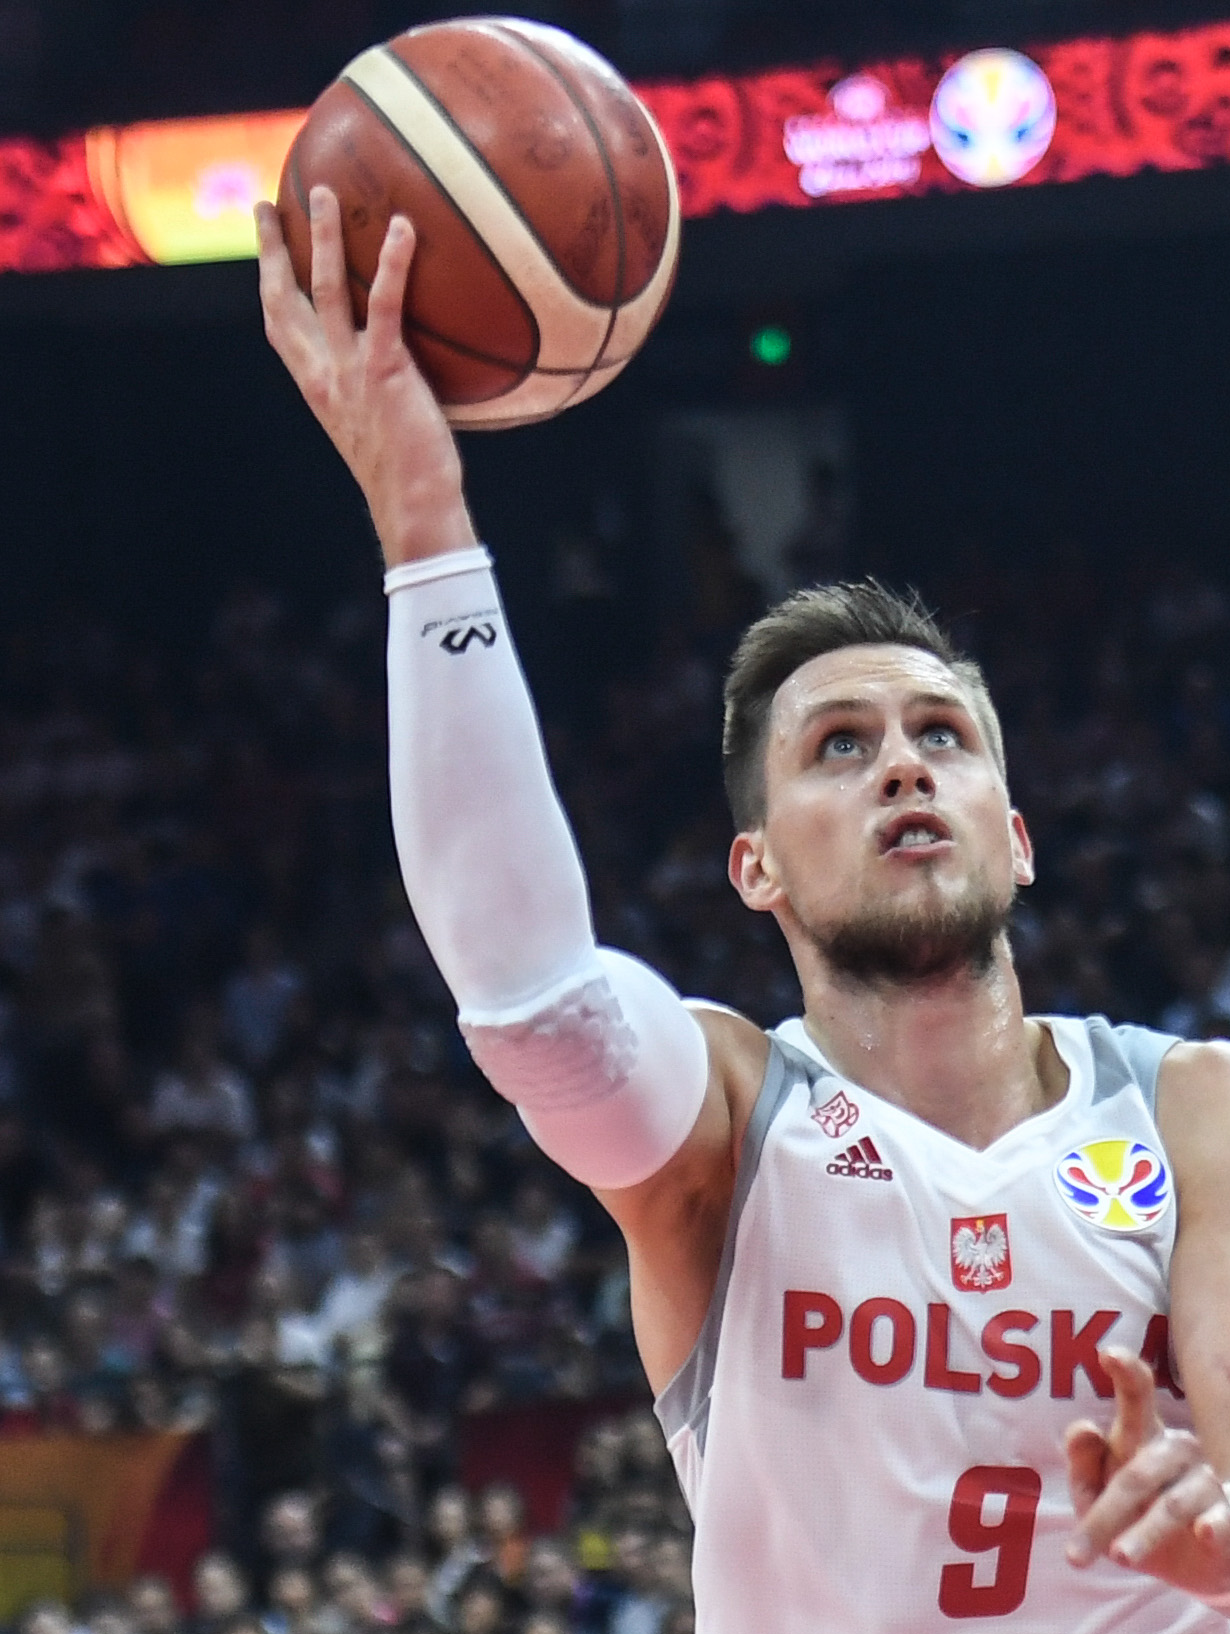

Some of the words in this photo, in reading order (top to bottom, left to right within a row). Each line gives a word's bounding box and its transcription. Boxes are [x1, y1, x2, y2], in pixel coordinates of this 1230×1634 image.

[826, 1161, 893, 1181] adidas
[781, 1290, 1186, 1400] POLSKA
[937, 1465, 1042, 1619] 9
